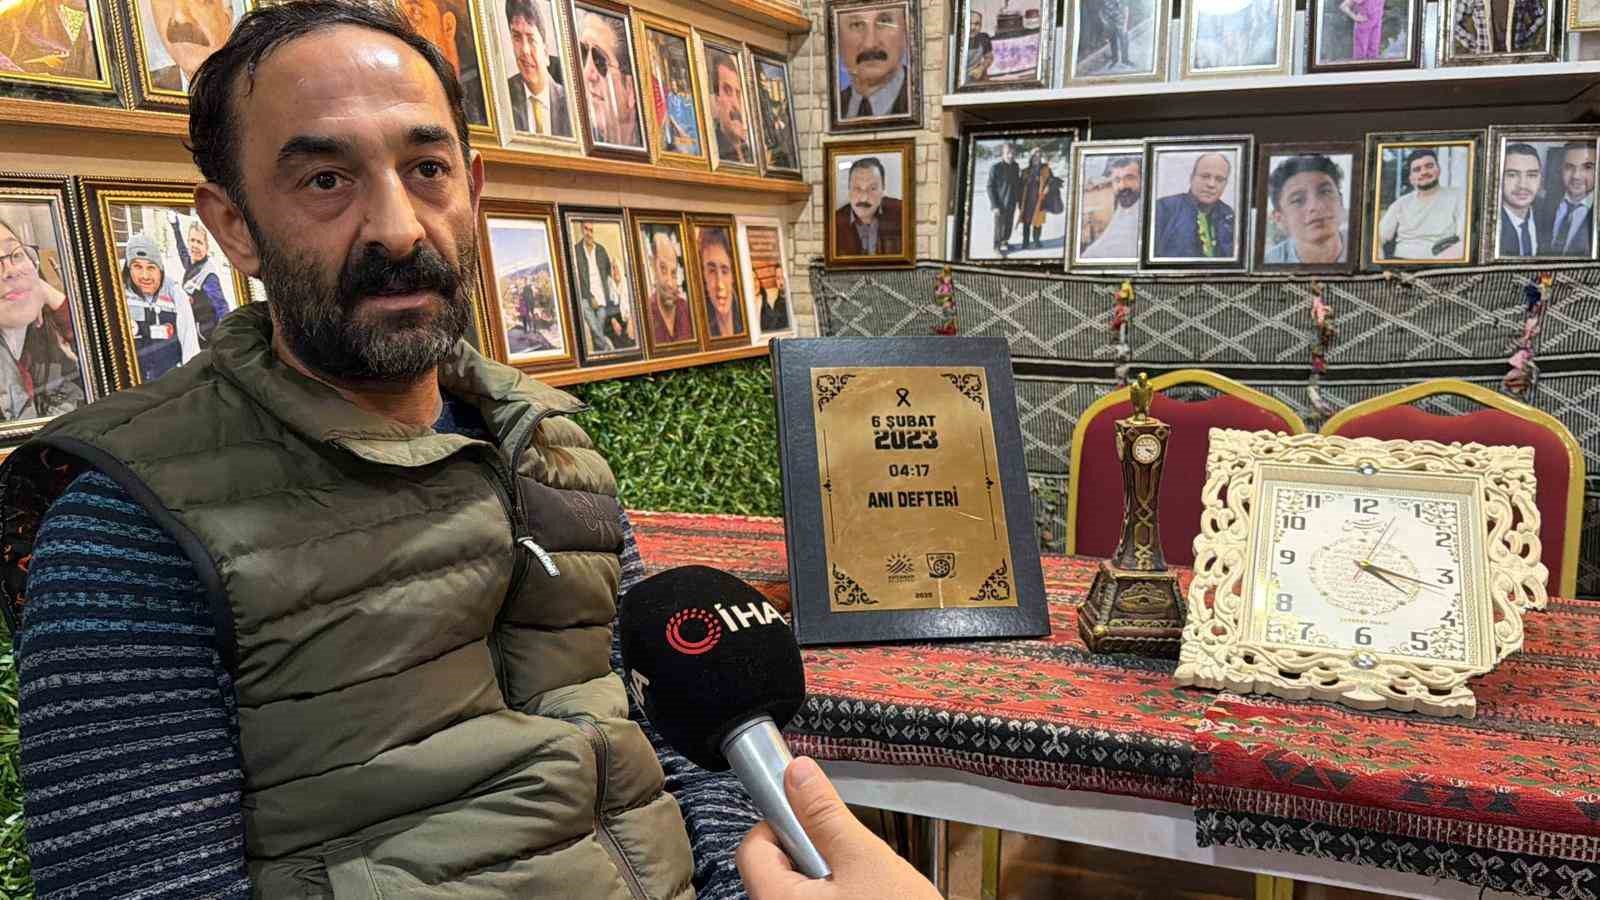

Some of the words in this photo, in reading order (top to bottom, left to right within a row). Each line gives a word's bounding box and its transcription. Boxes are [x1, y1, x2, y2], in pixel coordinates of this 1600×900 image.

[871, 415, 881, 429] 6
[886, 415, 937, 429] ŞUBAT
[873, 430, 939, 450] 2023
[888, 464, 930, 478] 04:17
[868, 491, 894, 509] ANI
[898, 486, 960, 508] DEFTERİ
[1306, 494, 1321, 508] 11
[1353, 498, 1380, 514] 12
[1413, 503, 1422, 518] 1
[1282, 514, 1306, 531] 10
[1435, 532, 1452, 547] 2
[1279, 549, 1296, 565] 9
[1436, 567, 1455, 585] 3
[1275, 593, 1293, 612] 8
[714, 602, 787, 632] İHA
[1440, 610, 1456, 627] 4
[1297, 621, 1315, 640] 7
[1354, 626, 1372, 645] 6
[1410, 631, 1429, 651] 5
